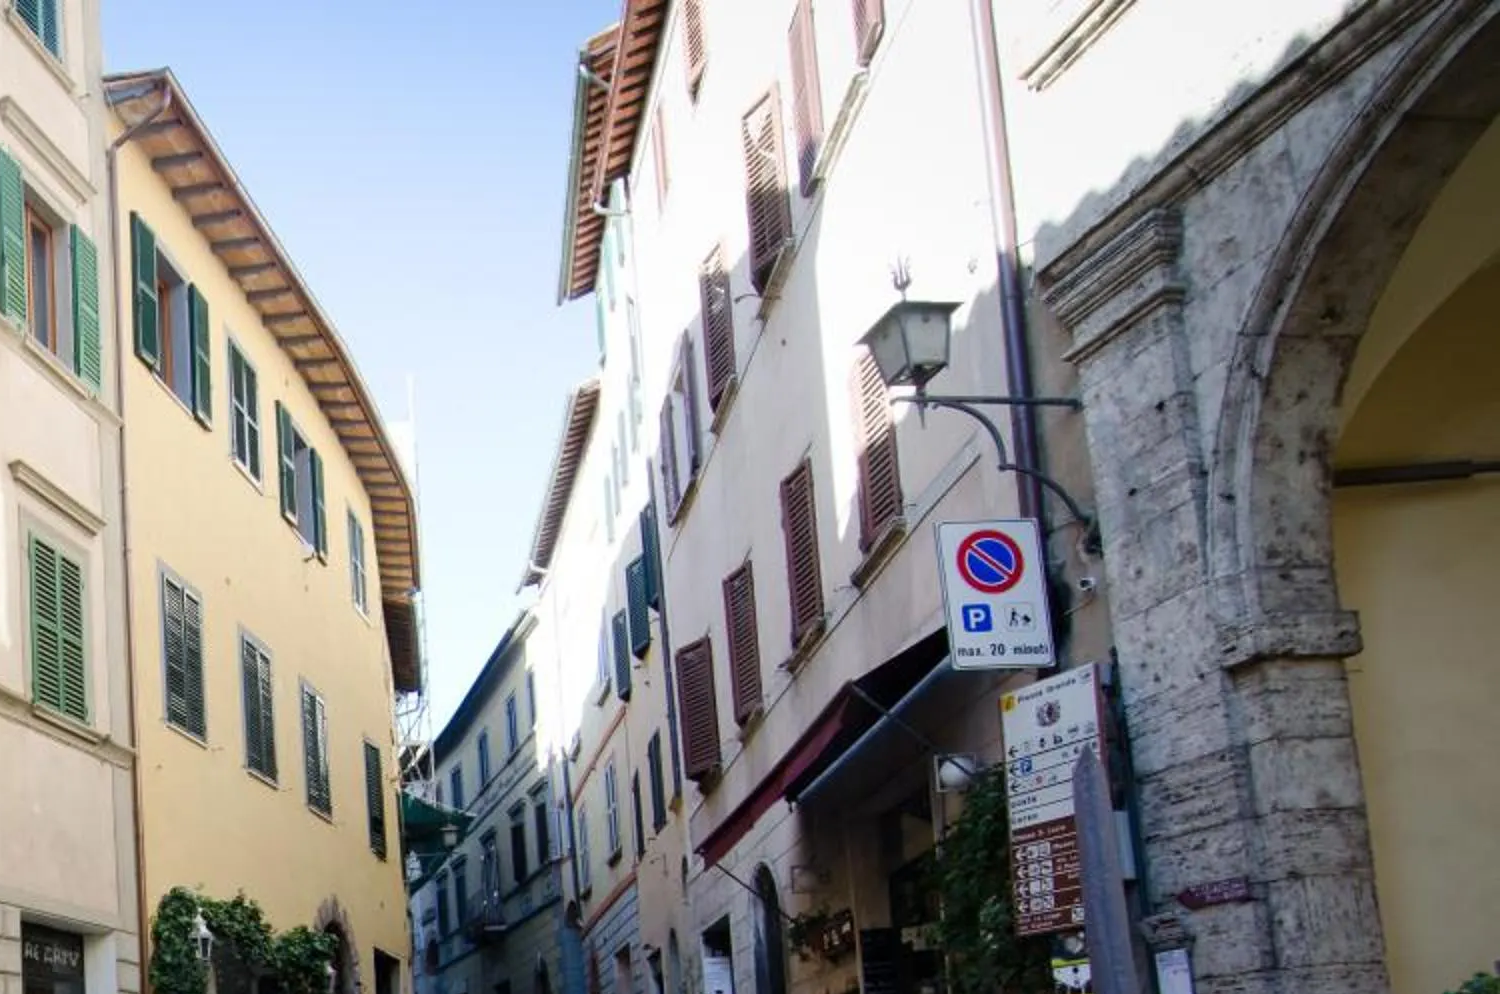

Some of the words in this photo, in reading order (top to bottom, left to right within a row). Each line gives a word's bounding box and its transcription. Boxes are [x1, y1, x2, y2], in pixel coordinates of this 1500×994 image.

[969, 608, 987, 629] P
[957, 645, 984, 657] max.
[990, 643, 1006, 656] 20
